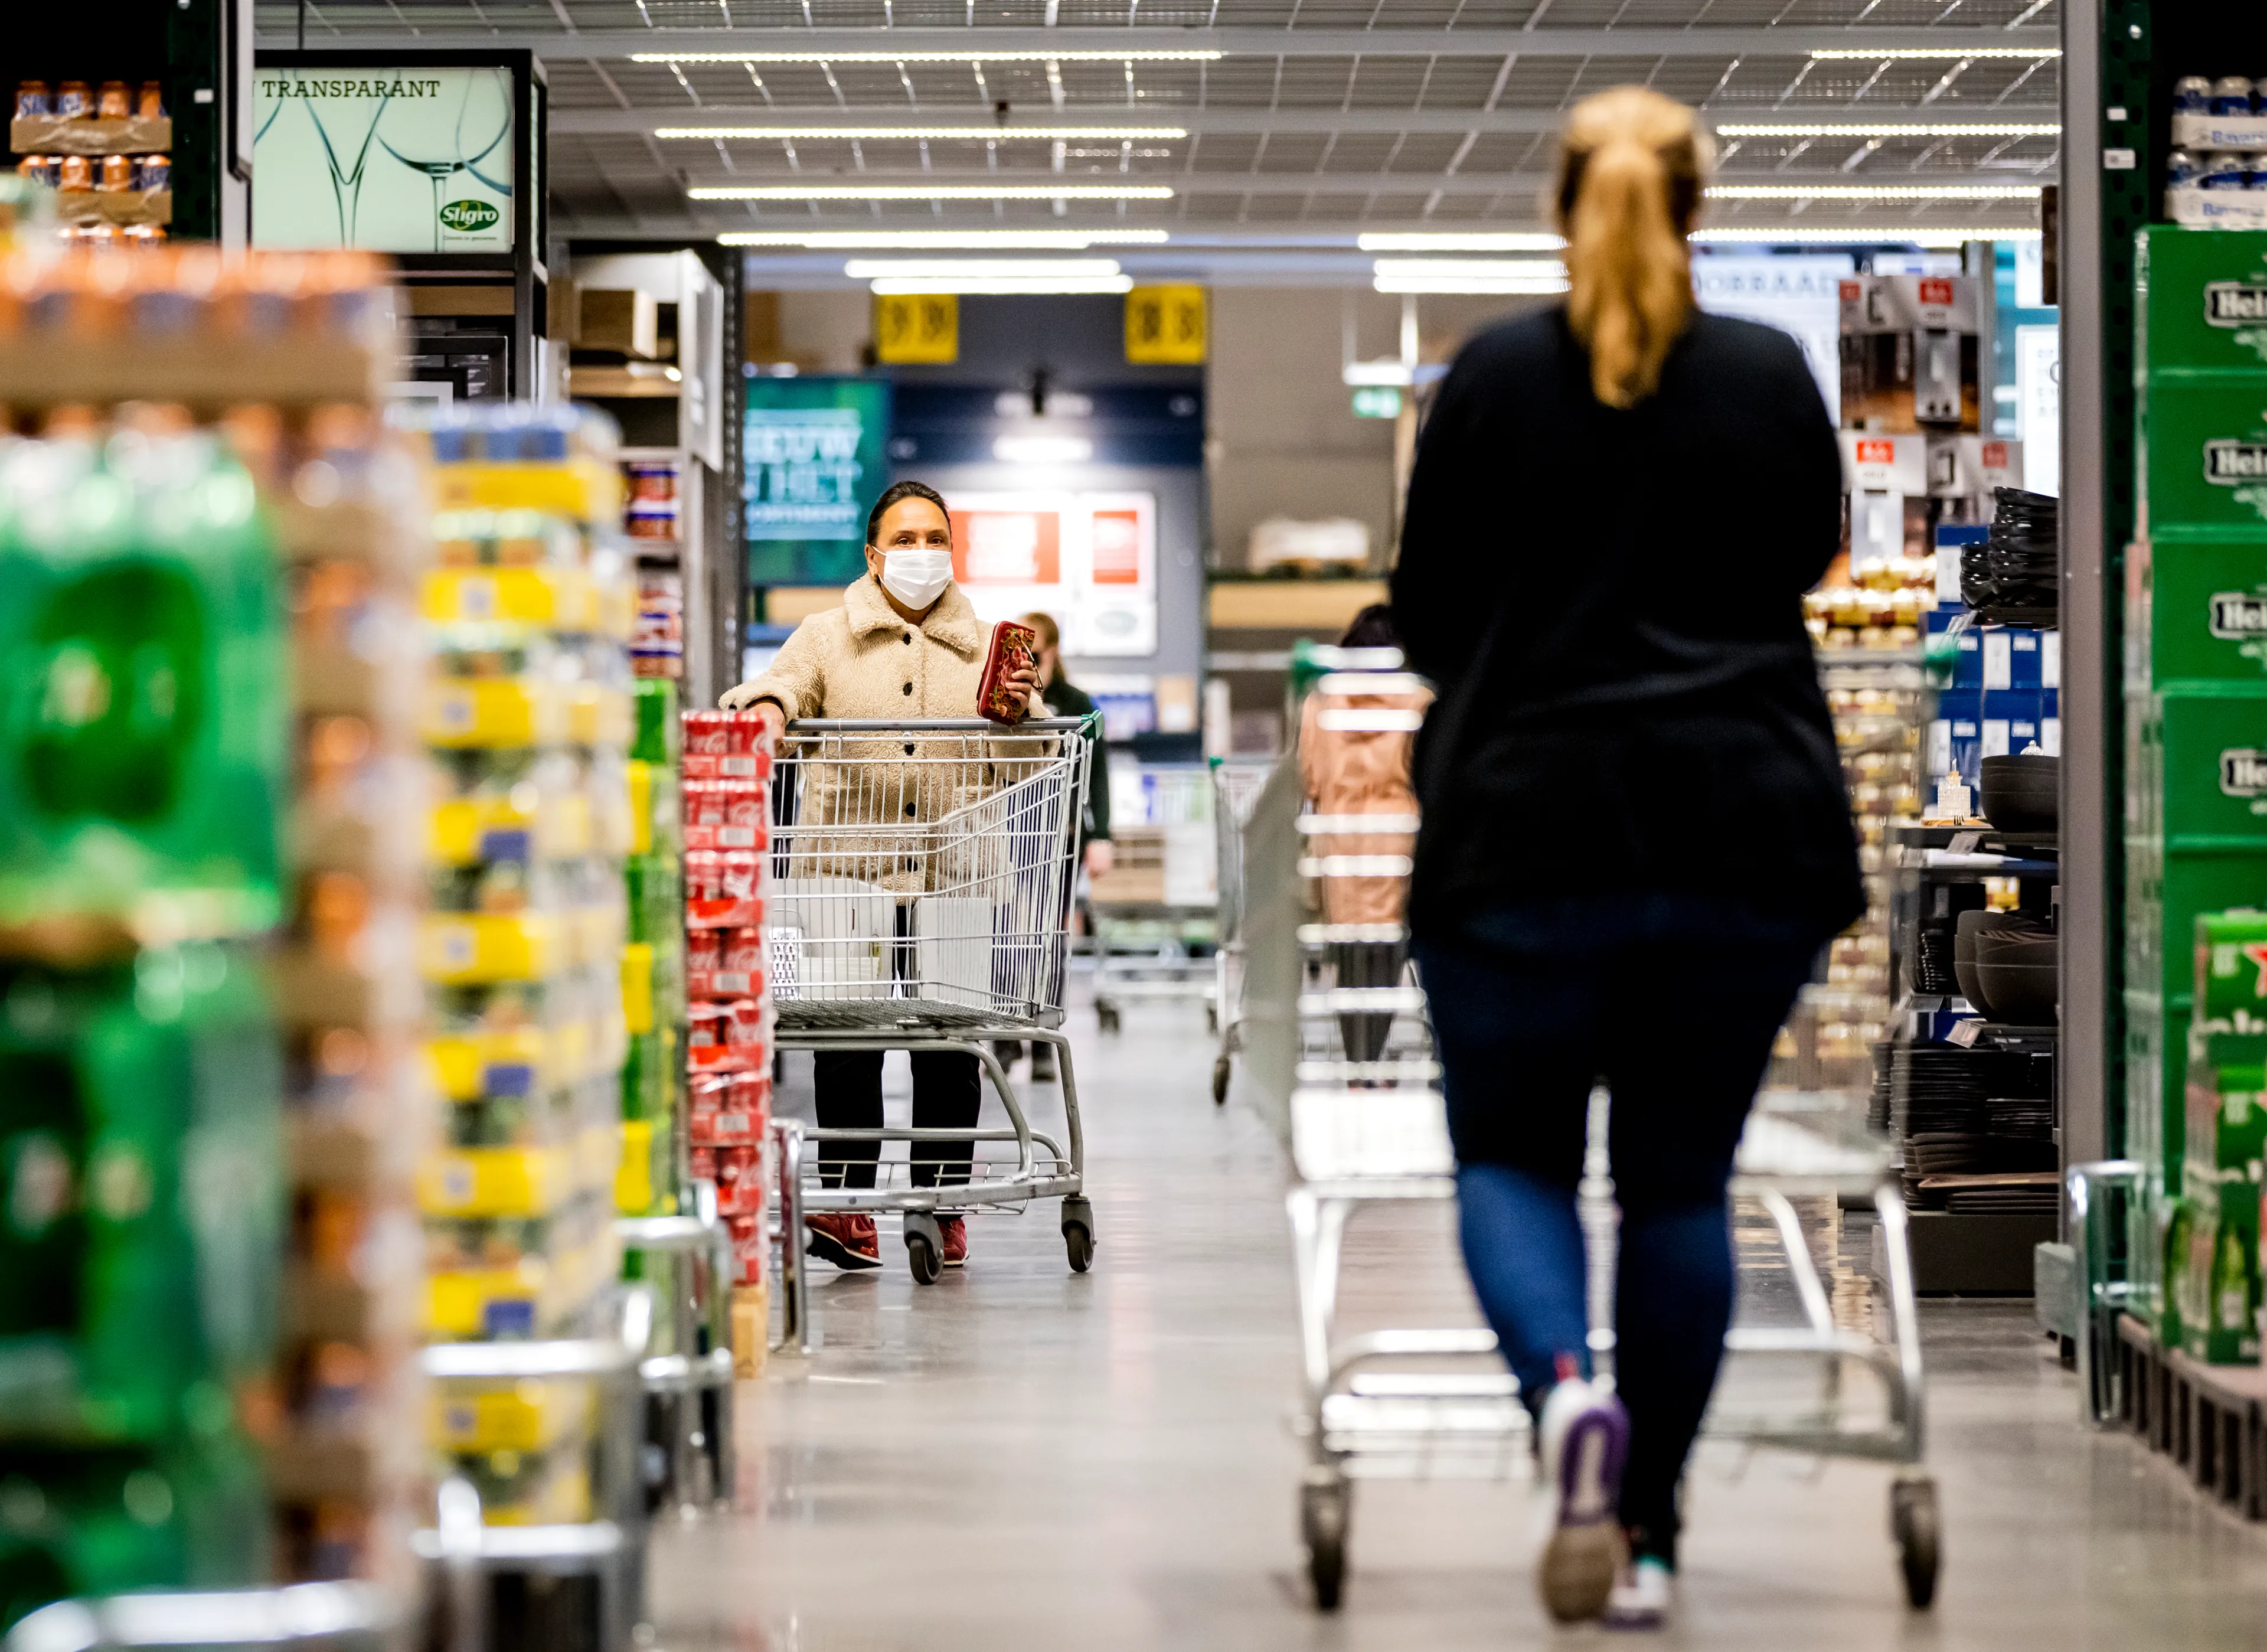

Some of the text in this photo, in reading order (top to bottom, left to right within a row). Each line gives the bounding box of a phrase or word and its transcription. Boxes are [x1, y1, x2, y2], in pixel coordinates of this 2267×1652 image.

[262, 80, 440, 97] TRANSPARANT
[442, 207, 498, 225] Sligro
[2219, 291, 2267, 317] Hei
[2217, 448, 2267, 475] Hei
